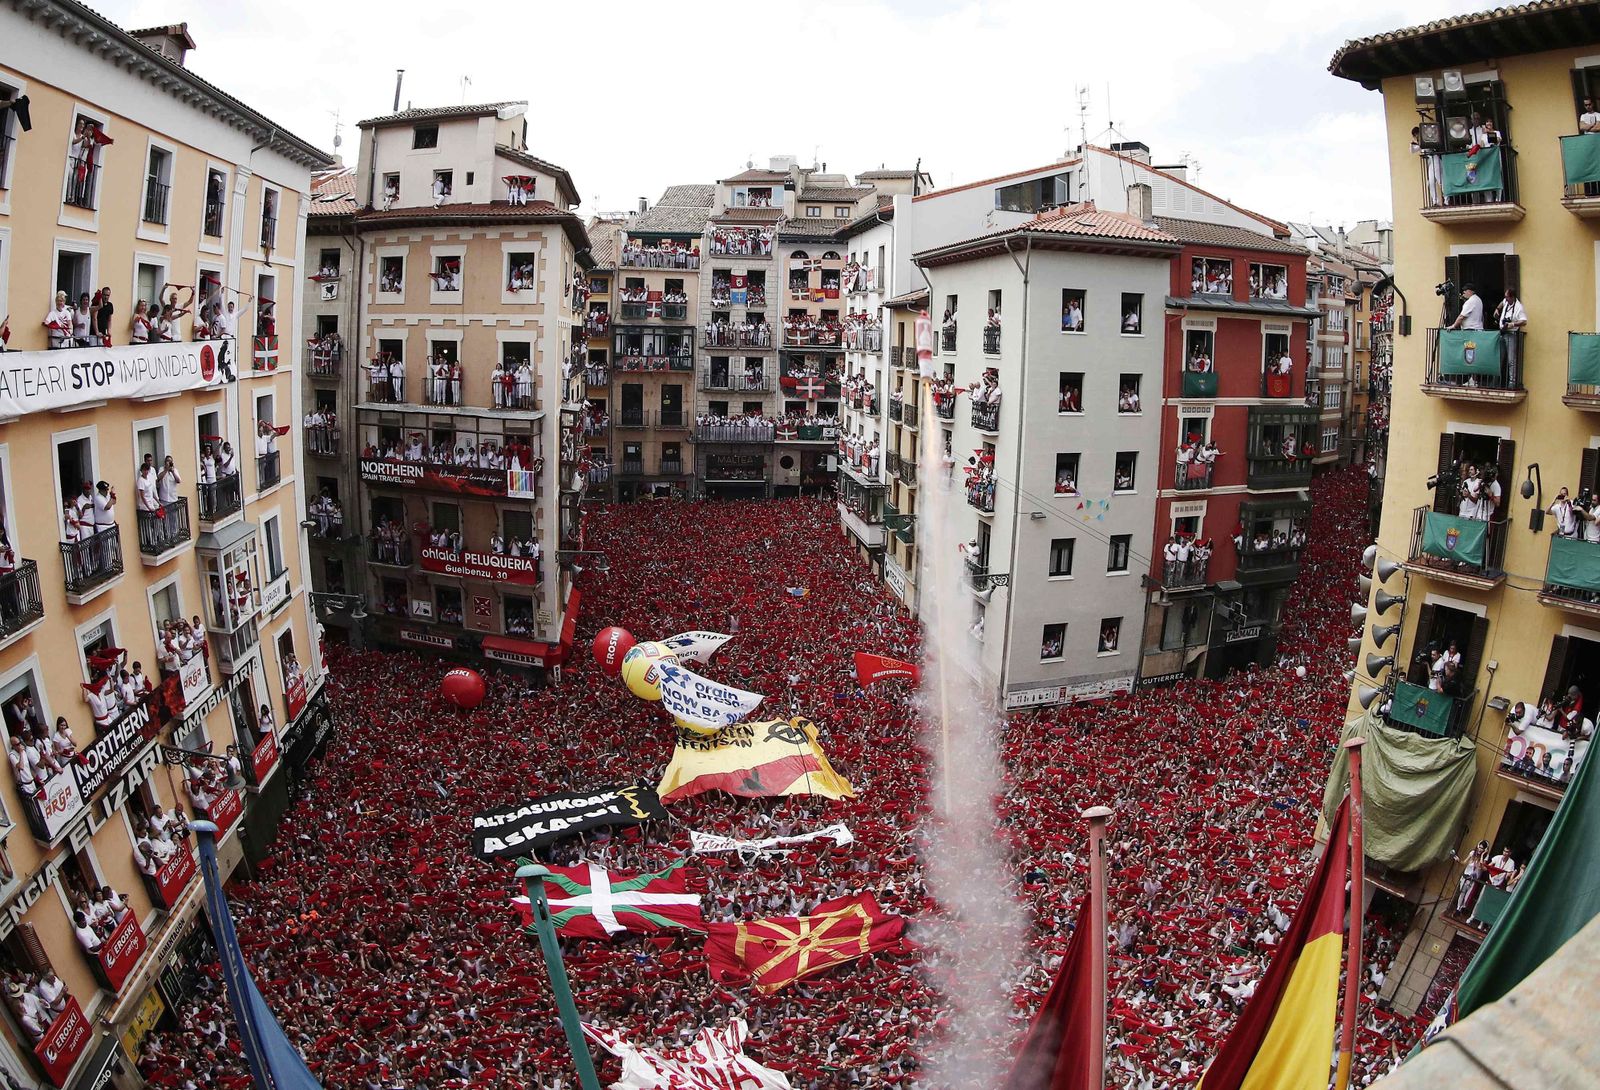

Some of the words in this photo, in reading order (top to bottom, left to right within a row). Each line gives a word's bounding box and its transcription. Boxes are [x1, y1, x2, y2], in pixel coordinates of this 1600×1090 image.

[0, 365, 67, 399] ATEARI
[71, 361, 115, 390] STOP
[119, 354, 198, 383] IMPUNIDAD
[361, 460, 425, 478] NORTHERN
[361, 472, 378, 481] SPAIN
[422, 548, 460, 562] ohlala!
[464, 553, 534, 571] PELUQUERIA
[496, 571, 508, 579] 30
[605, 631, 620, 665] EROSKI
[1142, 672, 1184, 685] GUTIERREZ
[173, 656, 260, 747] INMOBILIARIA
[75, 702, 150, 785] NORTHERN
[82, 769, 104, 798] SPAIN
[103, 734, 144, 776] TRAVEL.com
[69, 743, 163, 855] ELIZARI
[474, 791, 619, 829] ALTSASUKOAK
[113, 923, 135, 954] EROSKI
[55, 1012, 78, 1049] EROSKI
